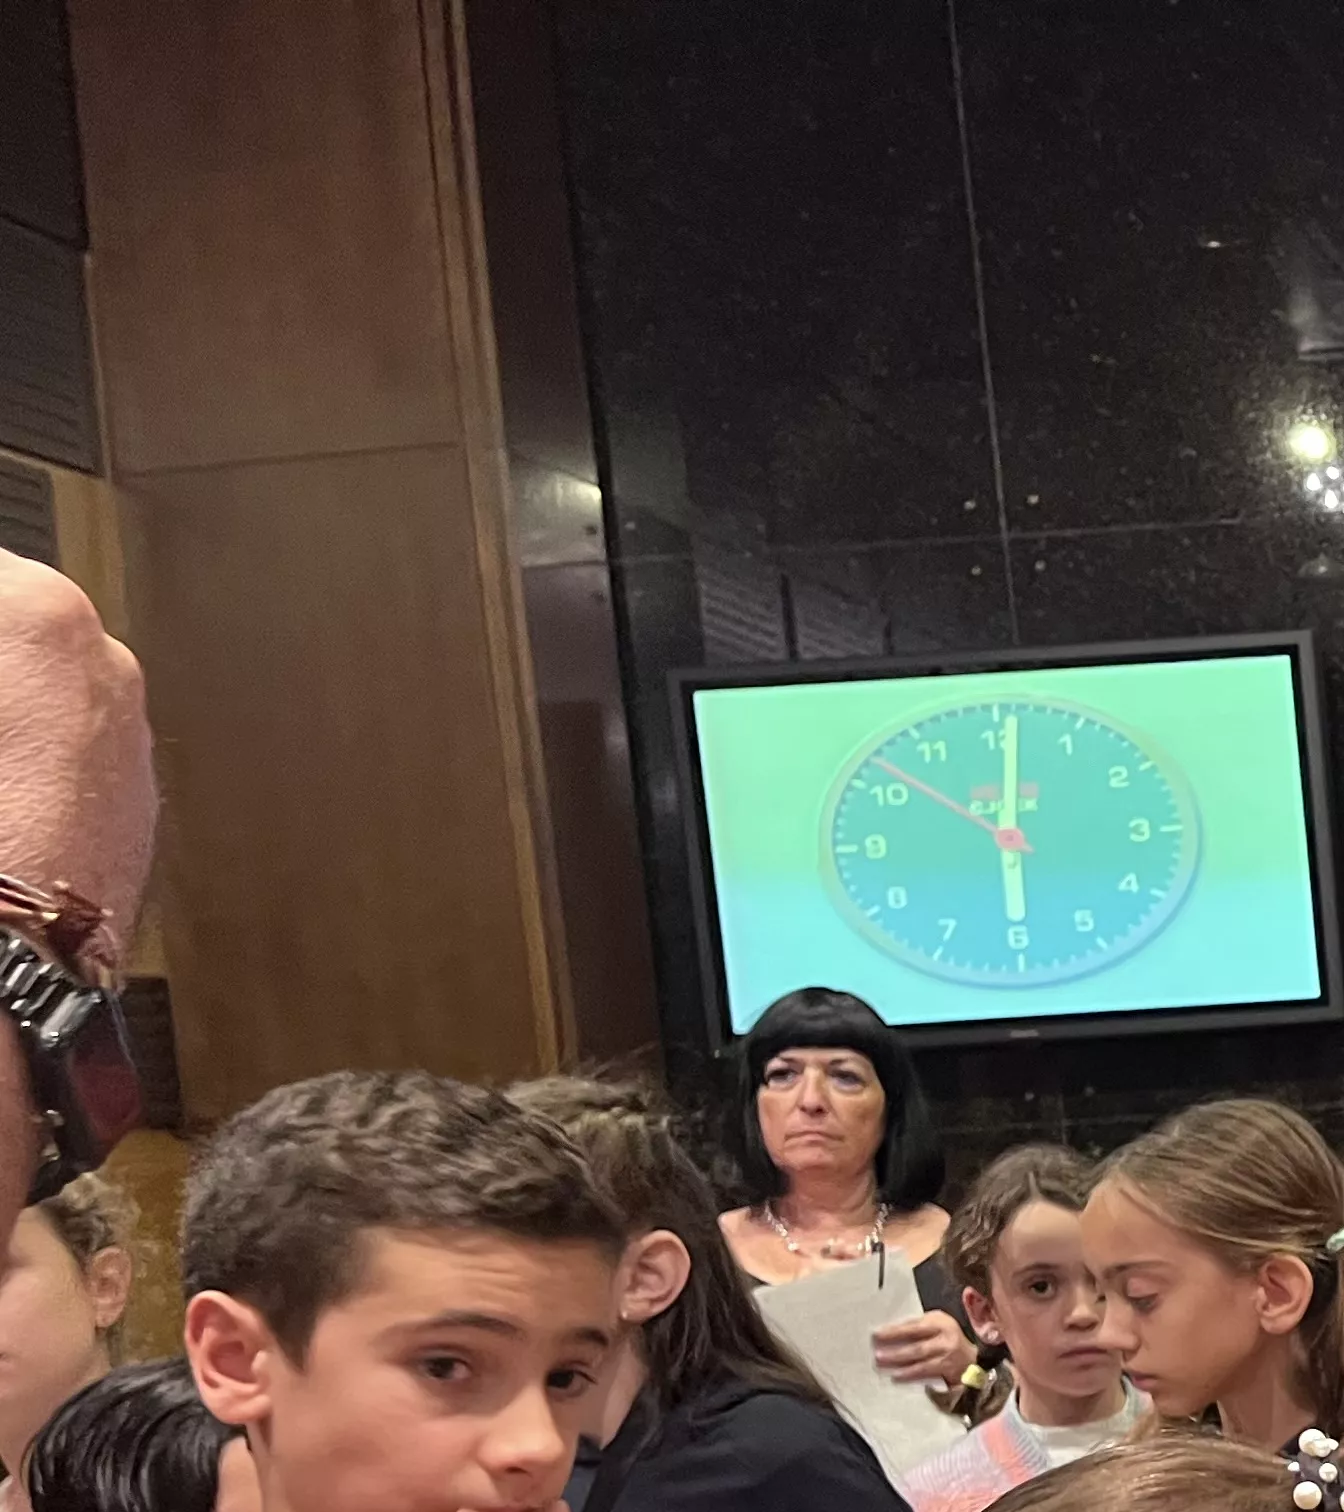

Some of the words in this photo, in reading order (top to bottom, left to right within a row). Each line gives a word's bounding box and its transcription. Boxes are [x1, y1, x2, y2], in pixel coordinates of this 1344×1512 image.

[917, 740, 947, 763] 11
[1057, 733, 1073, 756] 1
[1108, 765, 1130, 788] 2
[869, 782, 909, 807] 10
[1128, 817, 1151, 843] 3
[864, 834, 887, 859] 9
[1118, 871, 1139, 894] 4
[937, 918, 957, 942] 7
[1074, 909, 1094, 932] 5
[1007, 925, 1029, 949] 6
